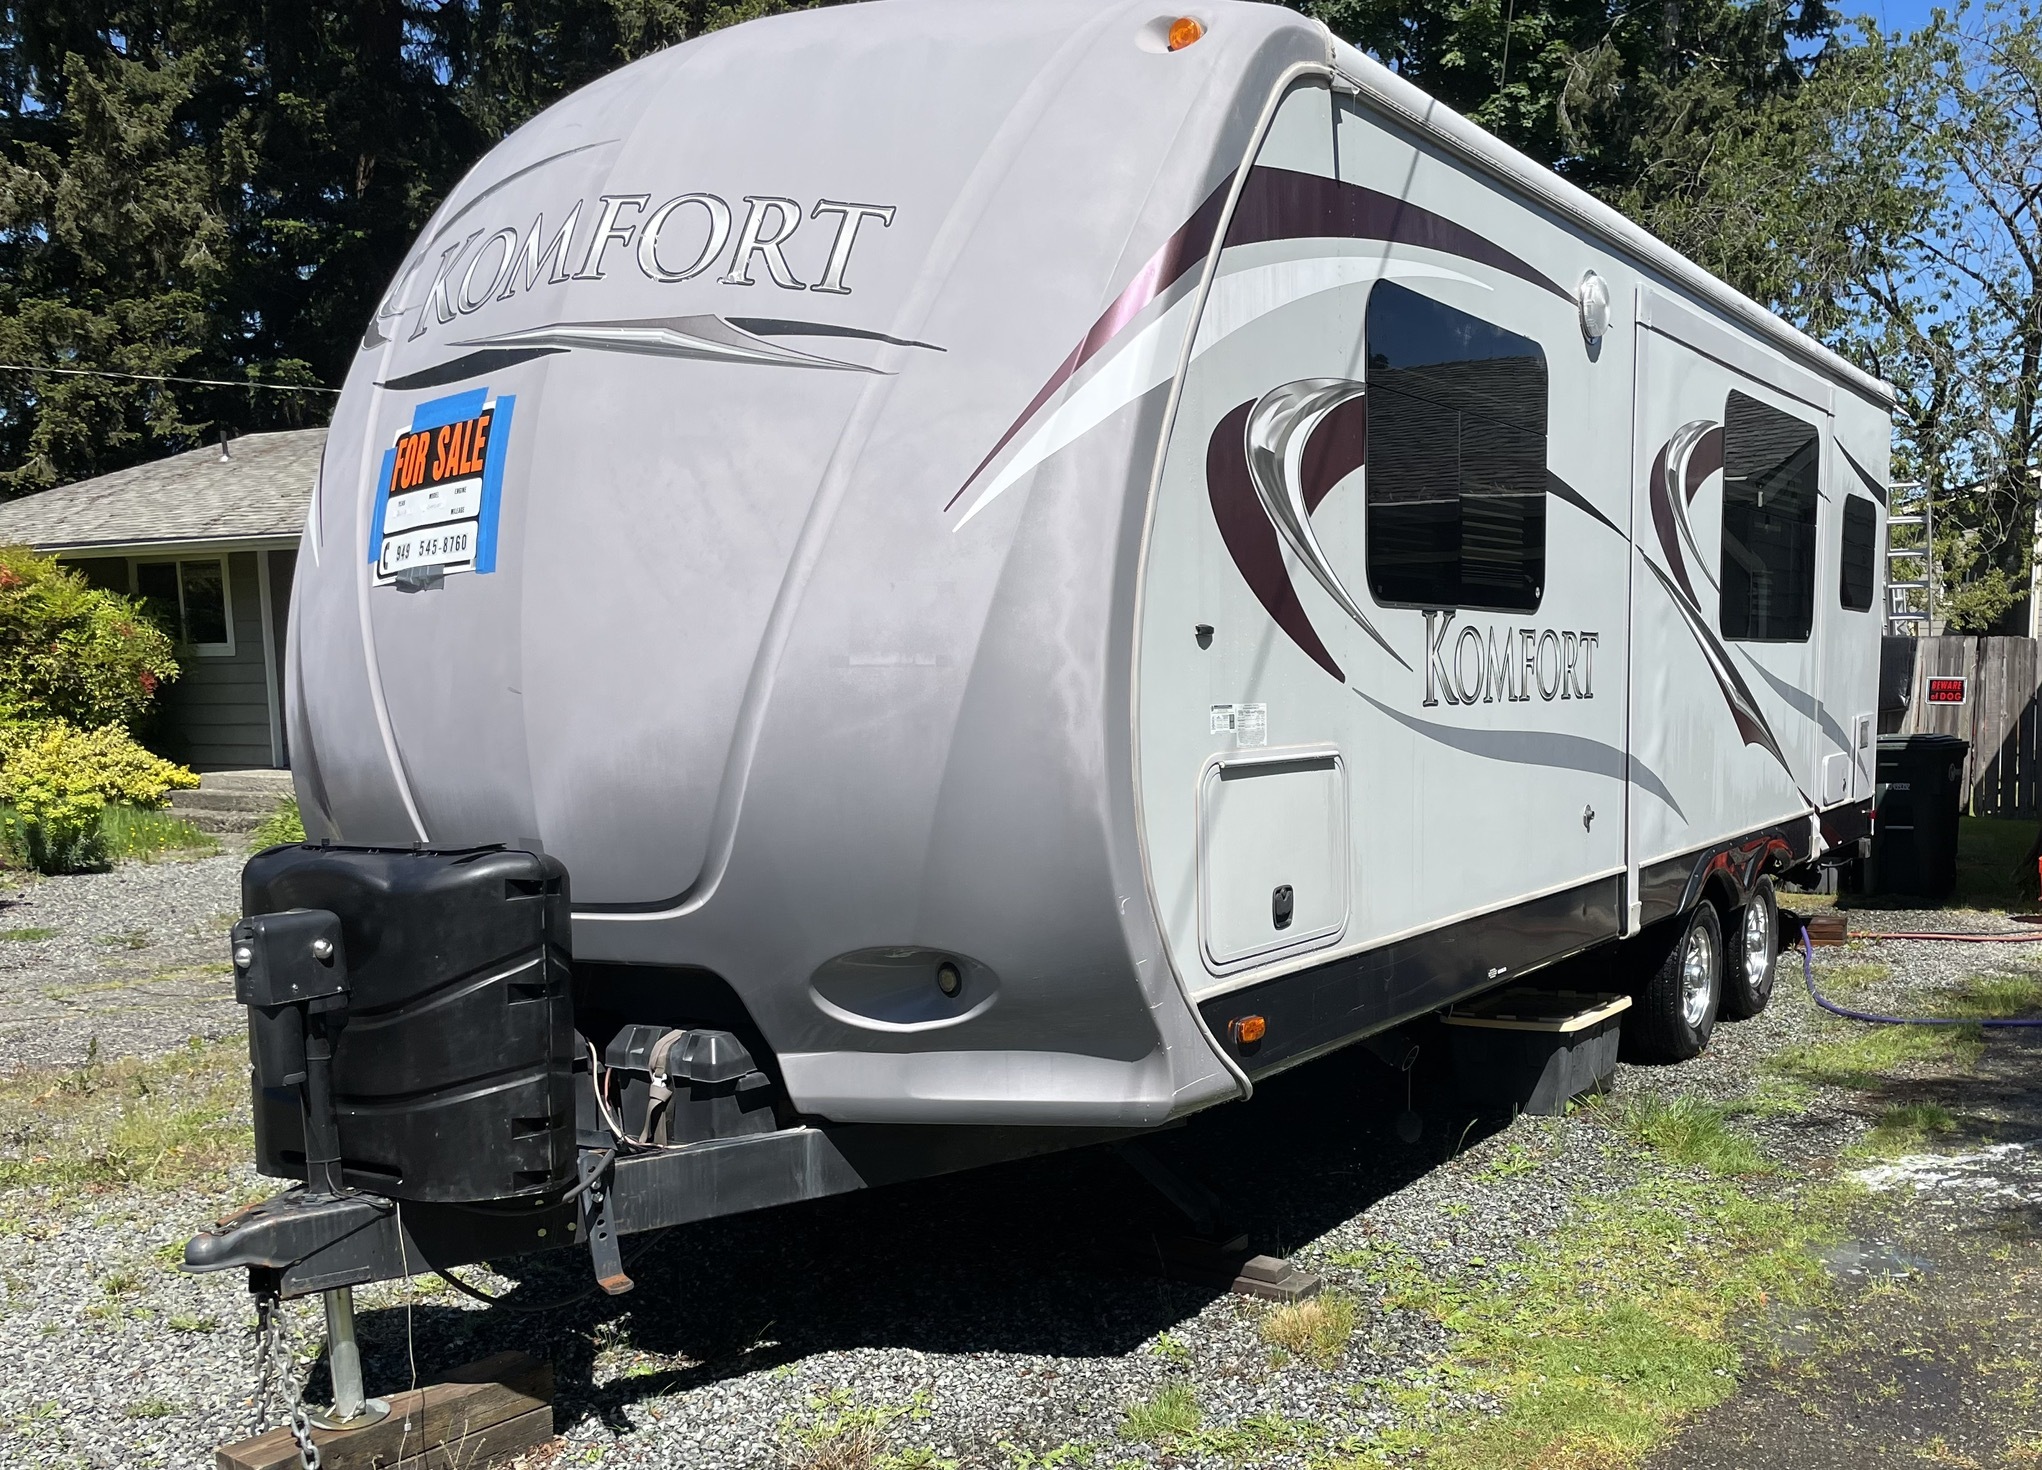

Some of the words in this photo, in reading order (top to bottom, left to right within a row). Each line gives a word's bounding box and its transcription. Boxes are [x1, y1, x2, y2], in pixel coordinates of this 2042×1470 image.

[408, 192, 896, 343] KOMFORT
[390, 431, 430, 492] FOR
[432, 415, 490, 481] SALE
[396, 543, 411, 561] 949
[419, 534, 467, 556] 545-8760
[1422, 610, 1599, 707] KOMFORT
[1930, 692, 1939, 700] of
[1940, 692, 1962, 700] DOG
[1931, 680, 1962, 690] BEWARE
